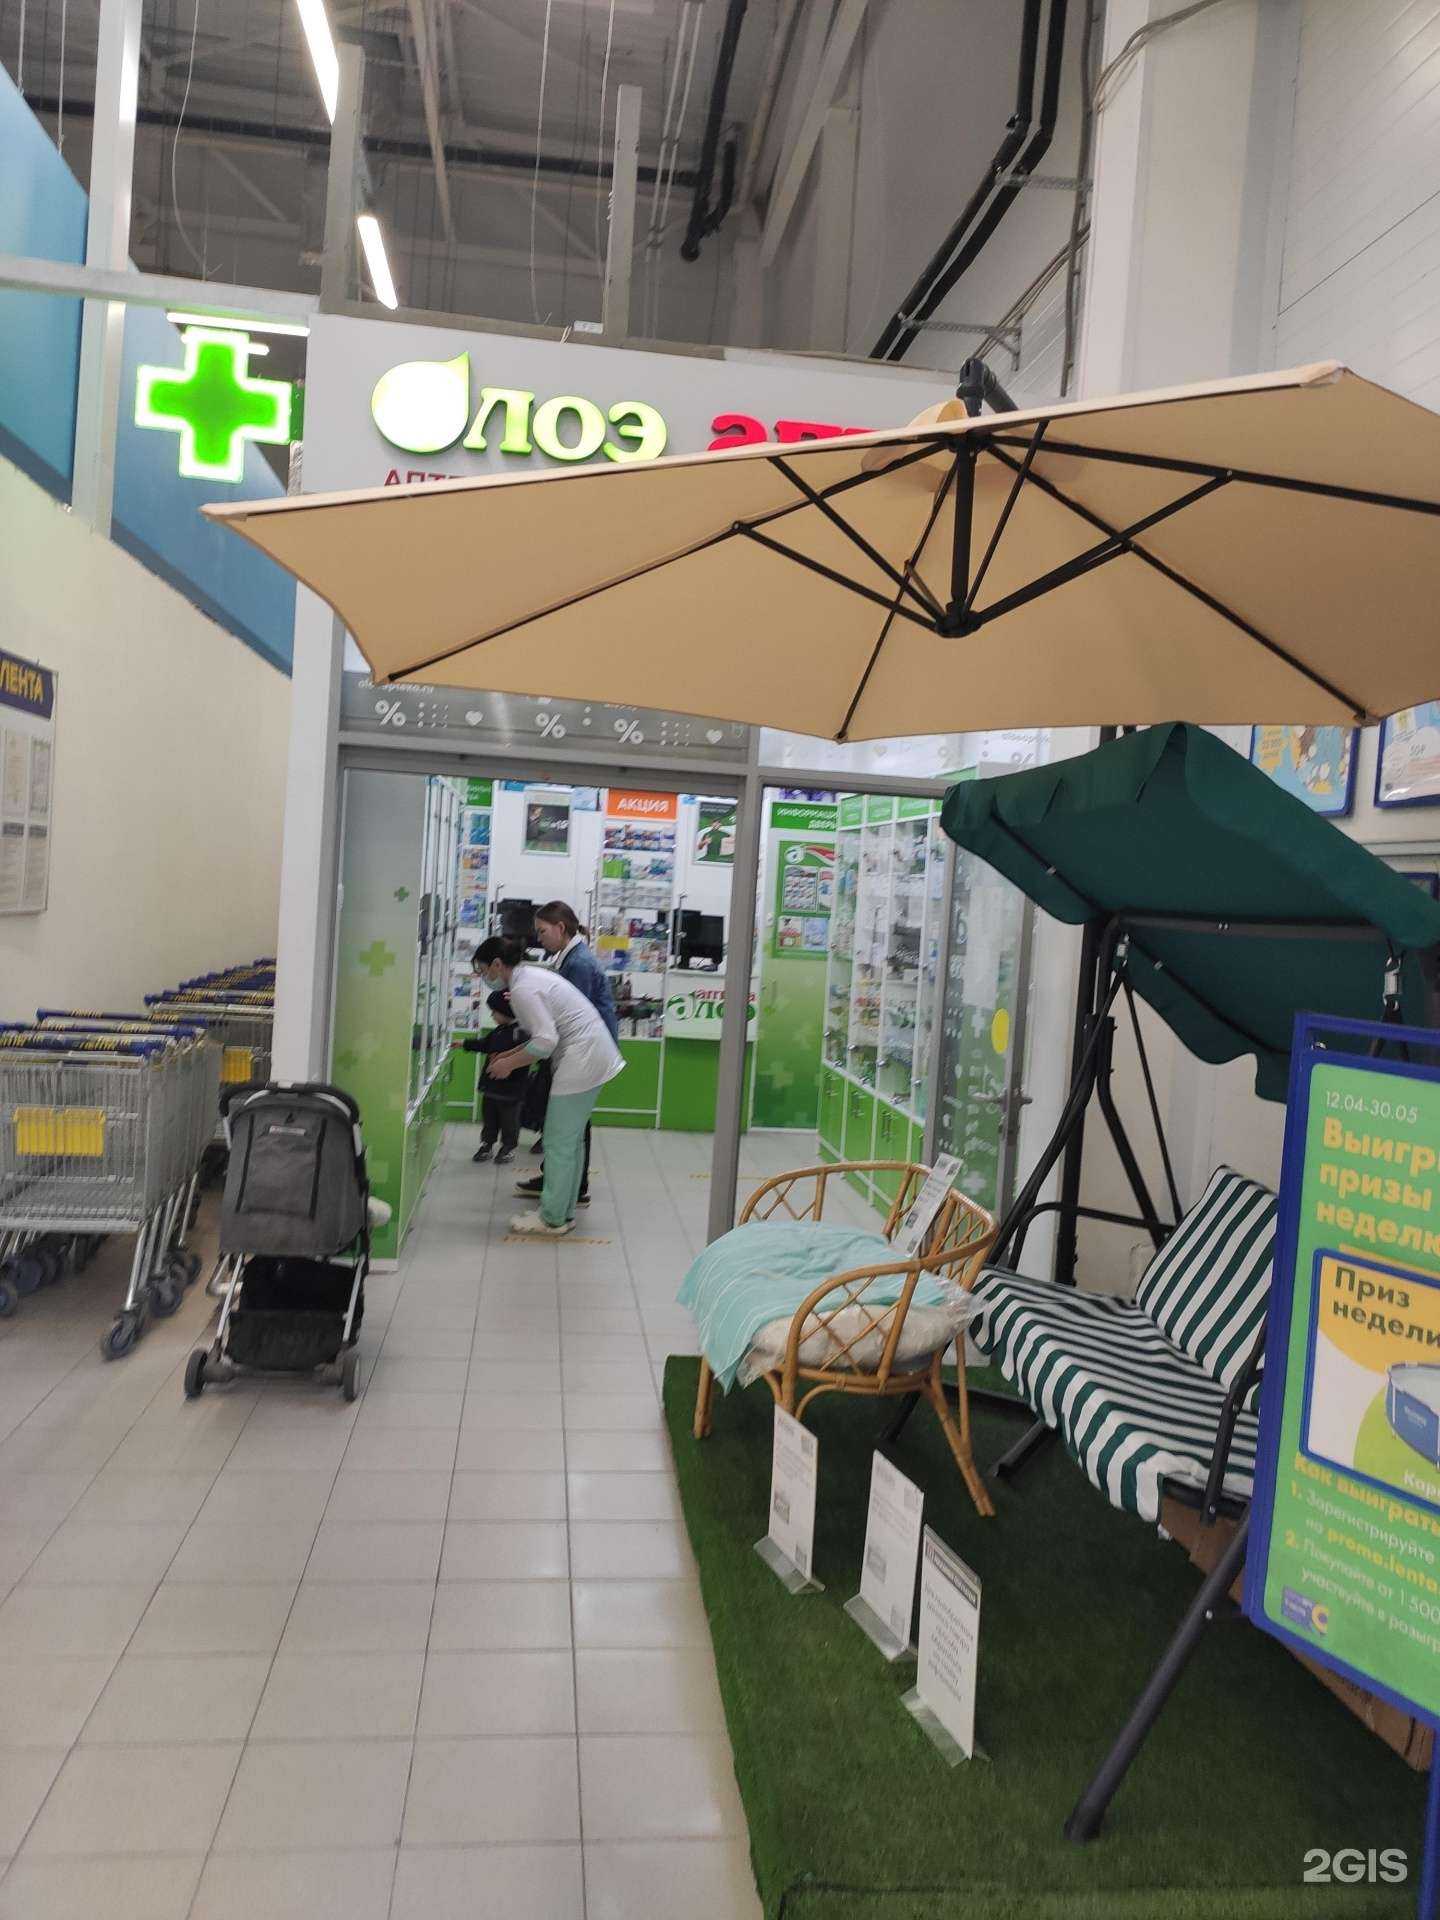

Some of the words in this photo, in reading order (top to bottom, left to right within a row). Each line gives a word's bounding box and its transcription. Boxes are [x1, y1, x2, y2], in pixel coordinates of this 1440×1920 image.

[617, 797, 669, 813] АКЦИЯ
[1323, 1116, 1440, 1178] Выигр
[1319, 1162, 1432, 1212] призы
[1335, 1266, 1410, 1308] Приз
[1333, 1300, 1440, 1349] недели
